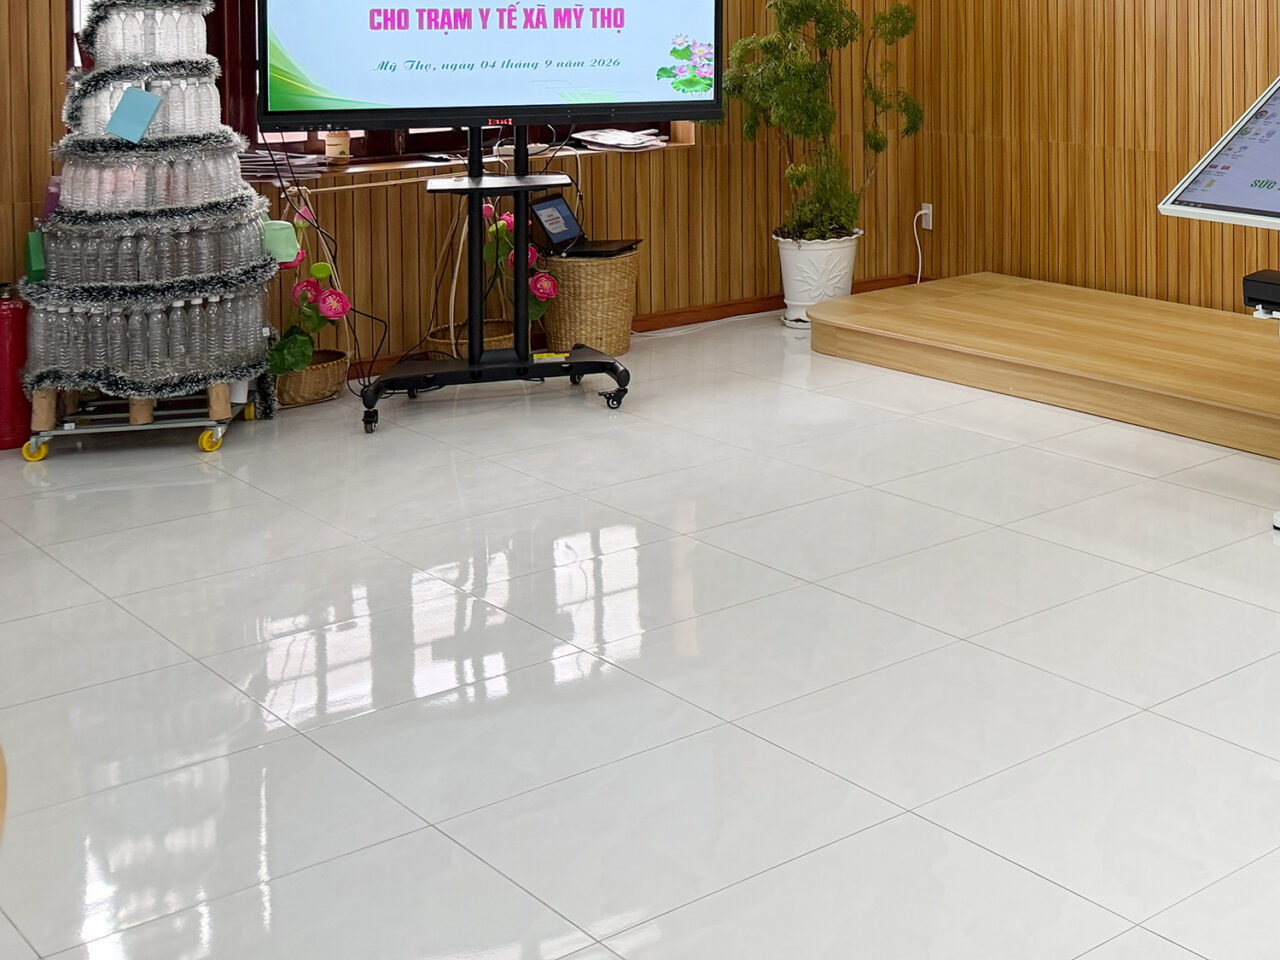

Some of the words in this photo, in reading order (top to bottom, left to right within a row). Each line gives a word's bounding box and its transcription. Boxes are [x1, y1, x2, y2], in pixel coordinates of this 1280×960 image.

[369, 8, 410, 31] CHO
[415, 8, 473, 36] TRẠM
[478, 8, 490, 30] Y
[498, 1, 519, 30] TẾ
[522, 2, 548, 30] XÃ
[553, 1, 584, 30] MỸ
[589, 7, 626, 34] THỌ
[373, 60, 398, 73] Mỹ
[403, 59, 437, 72] Thọ,
[441, 60, 475, 72] ngày
[480, 60, 497, 70] 04
[500, 58, 539, 71] tháng
[544, 59, 553, 69] 9
[556, 59, 585, 69] năm
[589, 57, 621, 68] 2026
